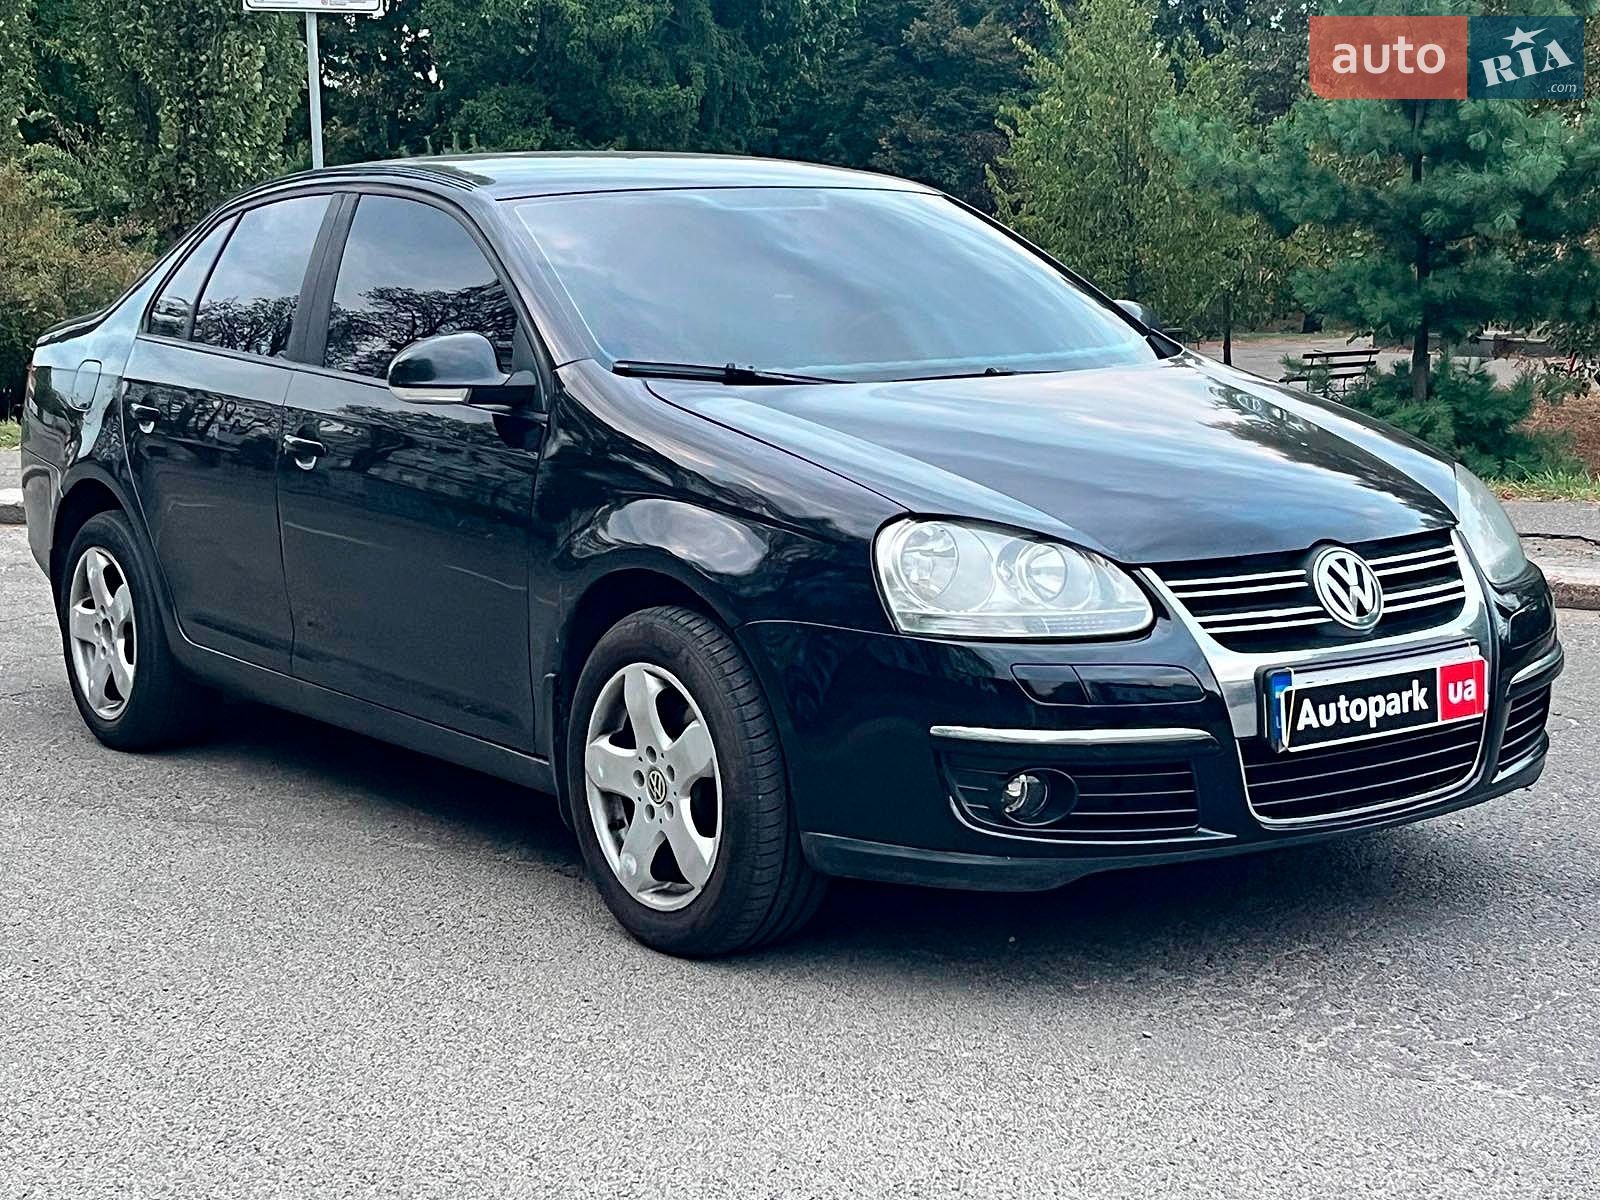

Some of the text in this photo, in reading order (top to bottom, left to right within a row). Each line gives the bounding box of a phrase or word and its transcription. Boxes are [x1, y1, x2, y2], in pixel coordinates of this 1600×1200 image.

[1322, 553, 1379, 620] VW
[1296, 678, 1477, 731] Autopark ua
[649, 771, 666, 803] VW
